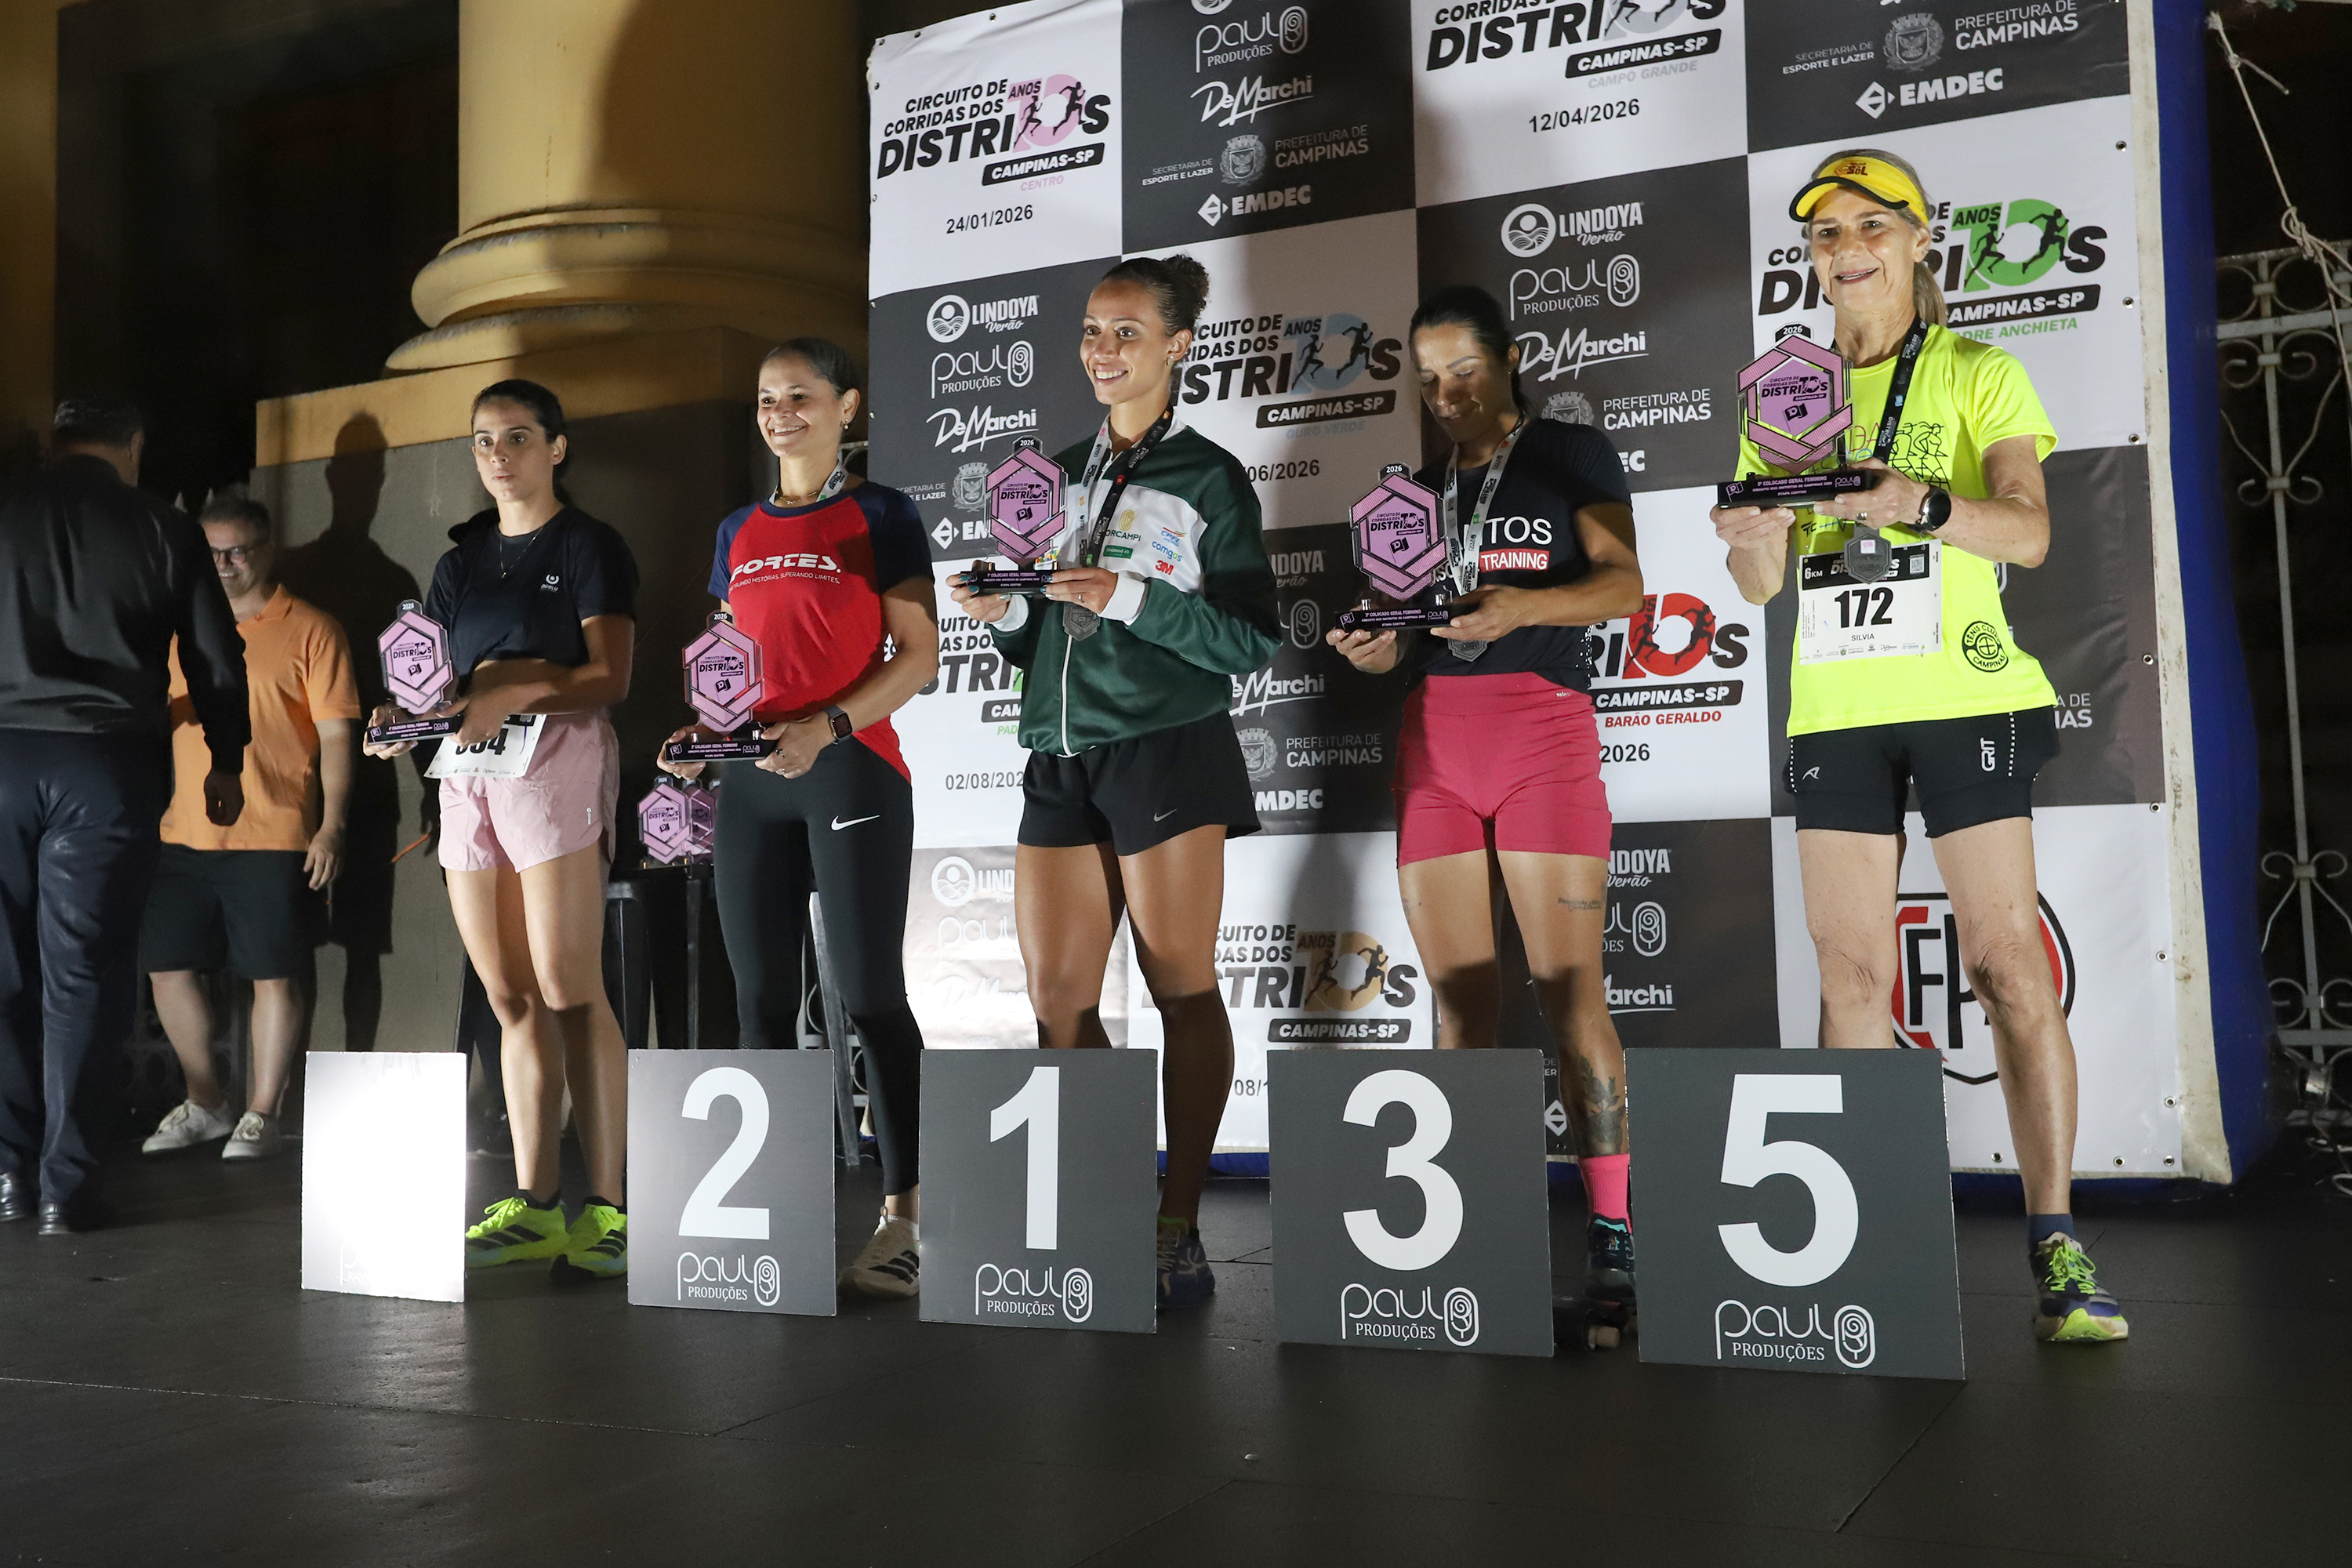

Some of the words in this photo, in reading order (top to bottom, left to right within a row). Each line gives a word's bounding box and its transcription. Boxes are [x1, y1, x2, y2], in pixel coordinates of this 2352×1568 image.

[1955, 2, 2043, 31] PREFEITURA
[2048, 0, 2077, 14] DE
[1955, 13, 2078, 51] CAMPINAS
[1207, 43, 1273, 67] PRODUÇÕES
[1577, 35, 1708, 72] CAMPINAS-SP
[1795, 44, 1857, 62] SECRETARIA
[1859, 41, 1875, 52] DE
[1781, 59, 1830, 75] ESPORTE
[1831, 58, 1838, 67] E
[1840, 51, 1875, 66] LAZER
[1588, 71, 1636, 89] CAMPO
[1640, 60, 1698, 81] GRANDE
[906, 84, 982, 114] CIRCUITO
[986, 78, 1008, 96] DE
[1008, 80, 1042, 100] ANOS
[1900, 67, 2004, 107] EMDEC
[884, 106, 966, 137] CORRIDAS
[969, 98, 1004, 118] DOS
[1528, 98, 1640, 133] 12/04/2026
[1275, 129, 1348, 151] PREFEITURA
[1351, 125, 1368, 137] DE
[1275, 138, 1369, 168] CAMPINAS
[991, 149, 1095, 180] CAMPINAS-SP
[1152, 160, 1200, 176] SECRETARIA
[1203, 158, 1213, 166] DE
[1020, 175, 1065, 191] CENTRO
[1142, 172, 1179, 186] ESPORTE
[1187, 167, 1214, 179] LAZER
[1231, 185, 1312, 216] EMDEC
[946, 204, 1033, 234] 24/01/2026
[1559, 201, 1643, 237] LINDOYA
[1953, 206, 2002, 227] ANOS
[1577, 229, 1625, 246] Verão
[972, 295, 1038, 325] LINDOYA
[1523, 294, 1599, 315] PRODUÇÕES
[1945, 292, 2085, 325] AMPINAS-SP
[985, 320, 1024, 333] Verão
[1193, 318, 1254, 341] CUITO
[1258, 314, 1283, 332] DE
[1283, 316, 1322, 336] ANOS
[1783, 325, 1803, 335] 2026
[1955, 326, 1994, 341] DRE
[1998, 318, 2078, 338] ANCHIETA
[1239, 335, 1279, 354] DOS
[942, 376, 1002, 394] PRODUÇÕES
[1267, 397, 1385, 423] CAMPINAS-SP
[1603, 391, 1689, 412] PREFEITURA
[1691, 388, 1711, 402] DE
[1603, 402, 1712, 430] CAMPINAS
[1245, 459, 1320, 482] 06/2026
[1386, 465, 1403, 474] 2026
[897, 484, 934, 494] RETARIA
[922, 492, 946, 501] LAZER
[1156, 560, 1174, 575] 3M
[1269, 550, 1324, 576] NDOYA
[1481, 552, 1548, 571] TRAINING
[1276, 577, 1307, 588] erão
[1835, 586, 1894, 628] 172
[1851, 633, 1875, 642] SILVIA
[1966, 625, 1980, 643] TENIS
[1973, 655, 2005, 669] CAMPINAS
[1596, 686, 1730, 708] CAMPINAS-SP
[2070, 693, 2092, 707] DE
[997, 724, 1018, 735] PAD
[1605, 712, 1650, 728] BARÃO
[1655, 710, 1722, 725] GERALDO
[1287, 735, 1363, 750] PREFEITURA
[1365, 734, 1381, 746] DE
[1286, 747, 1383, 768] CAMPINAS
[946, 771, 1024, 790] 02/08/202
[1254, 789, 1323, 811] MDEC
[978, 869, 1014, 891] LIND
[1271, 924, 1296, 941] DE
[1298, 935, 1336, 949] ANOS
[1251, 946, 1292, 963] DOS
[1279, 1023, 1400, 1039] CAMPINAS-SP
[678, 1066, 769, 1240] 2
[990, 1066, 1059, 1250] 1
[1342, 1069, 1464, 1271] 3
[1718, 1074, 1859, 1287] 5
[688, 1286, 747, 1301] PRODUÇÕES
[986, 1299, 1054, 1318] PRODUÇÕES
[1356, 1323, 1436, 1341] PRODUÇÕES
[1732, 1341, 1824, 1363] PRODUÇÕES
